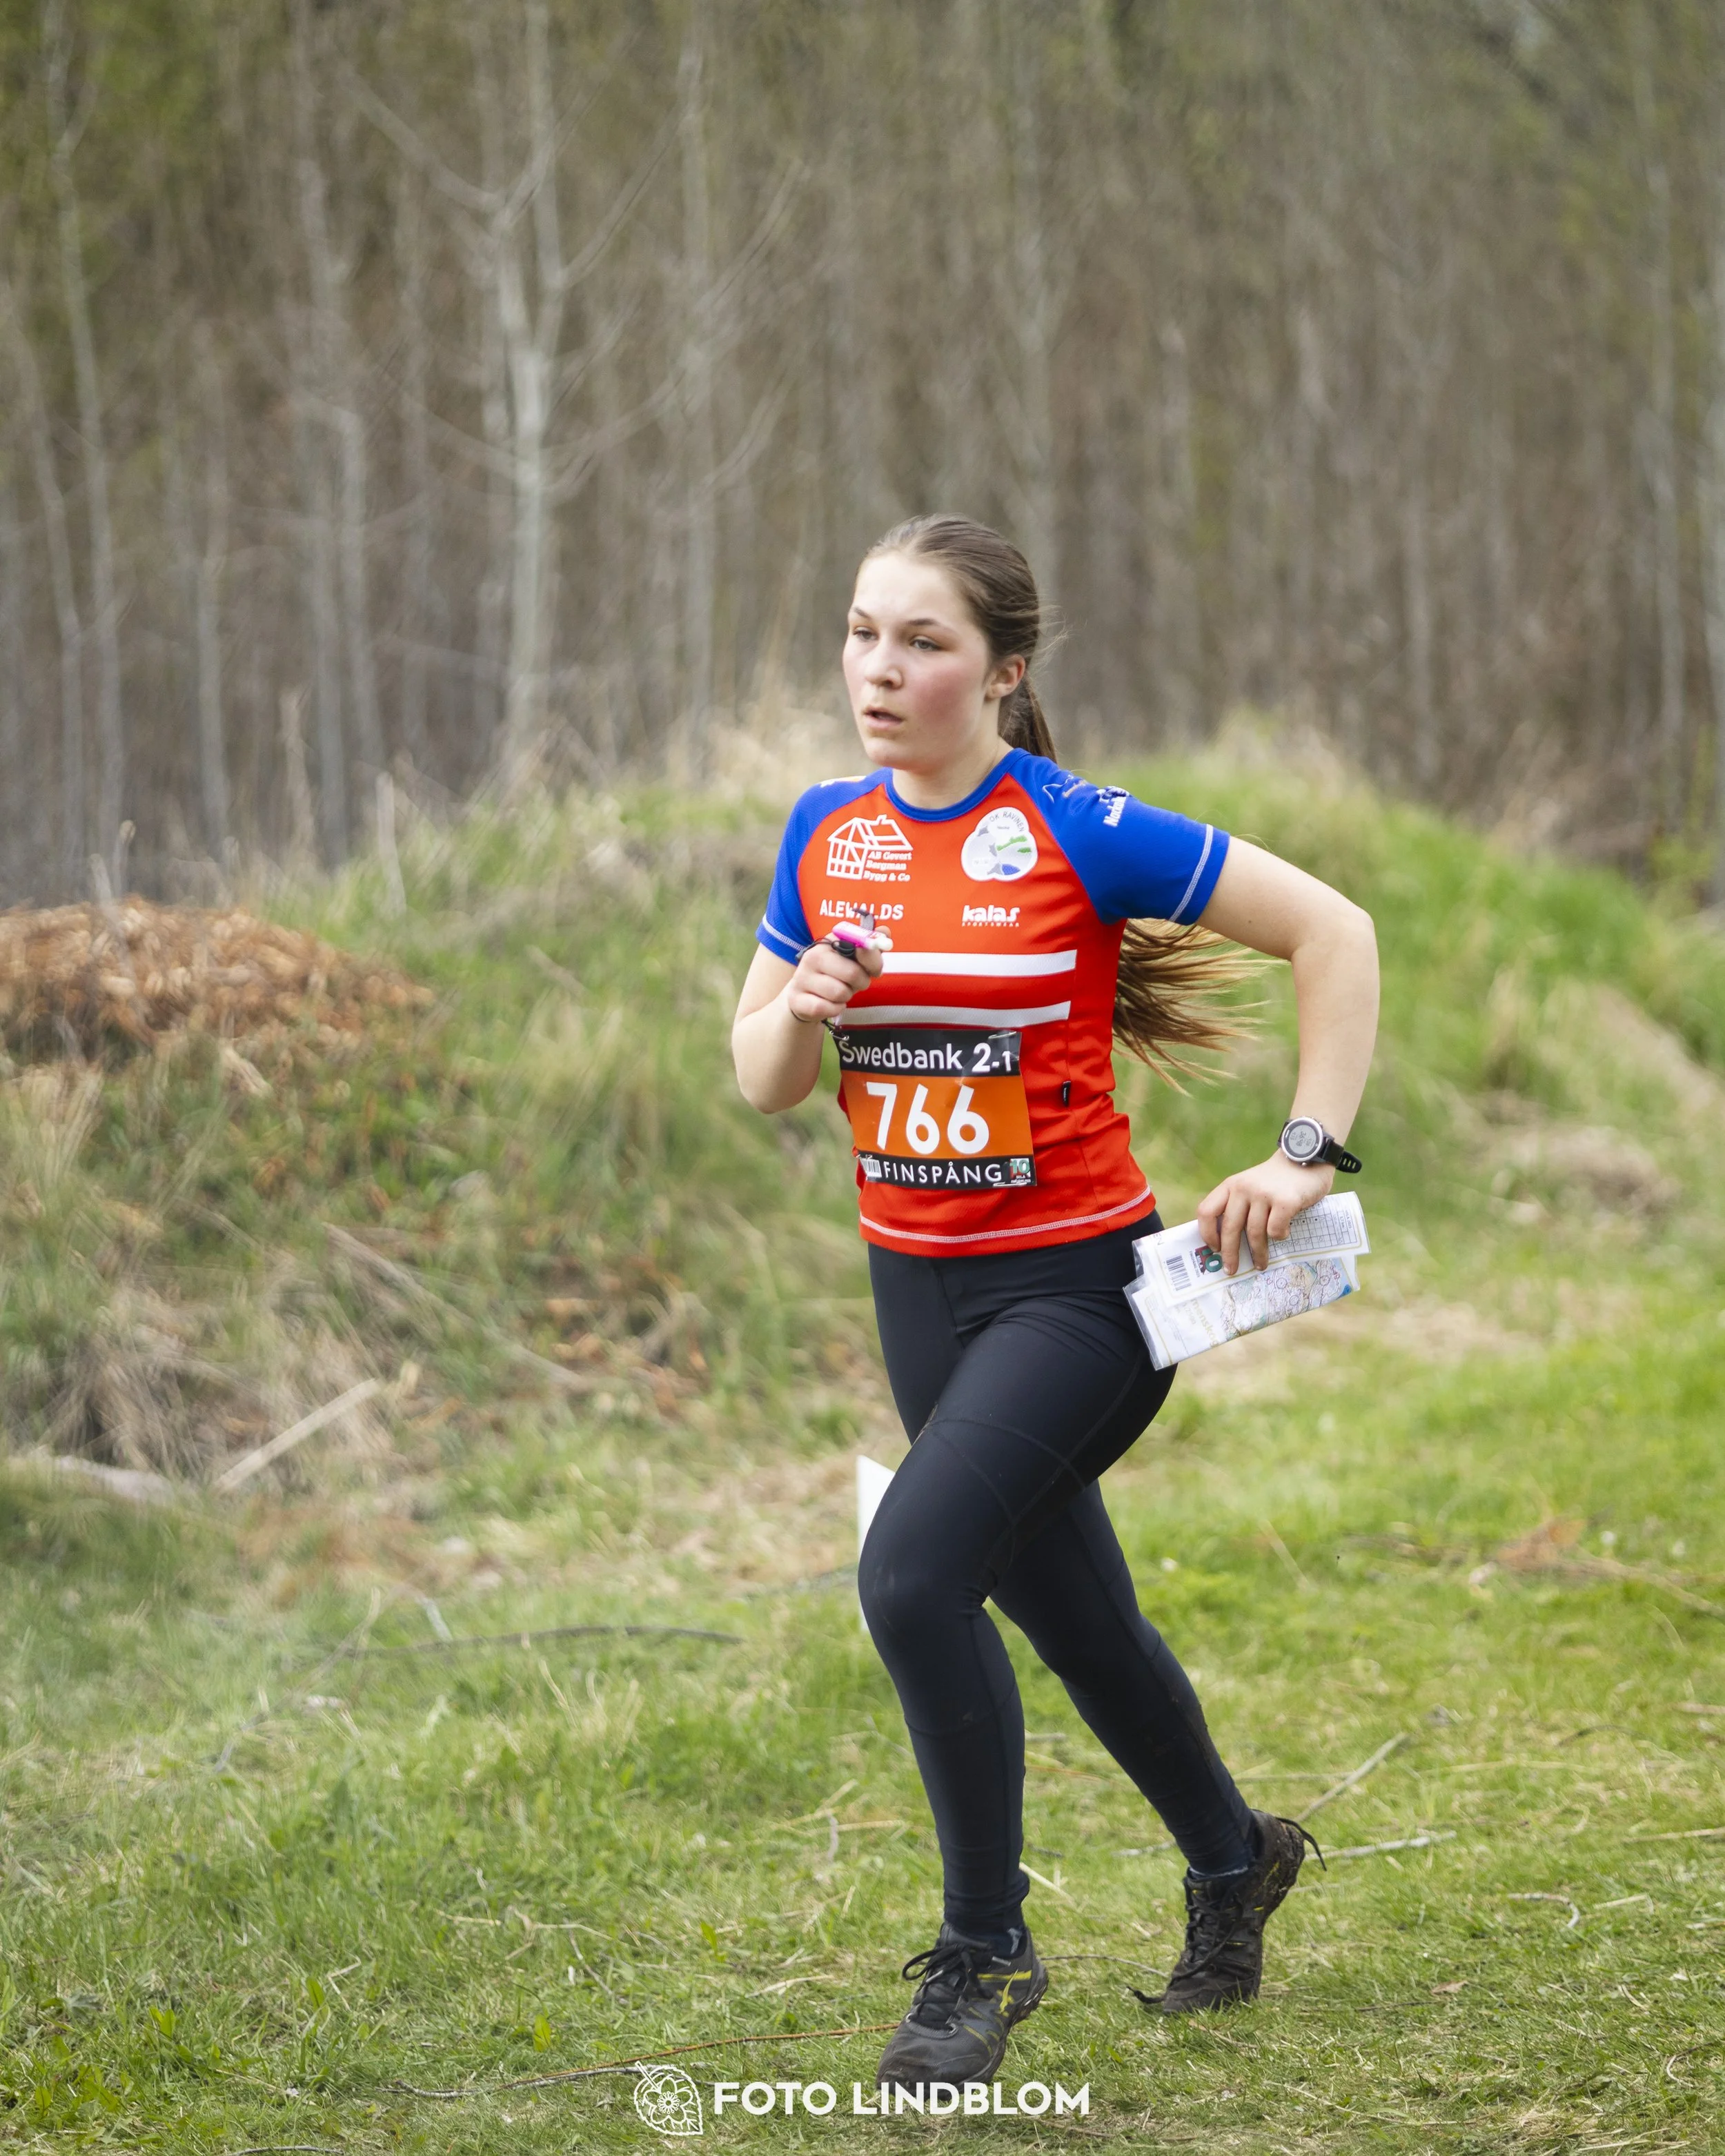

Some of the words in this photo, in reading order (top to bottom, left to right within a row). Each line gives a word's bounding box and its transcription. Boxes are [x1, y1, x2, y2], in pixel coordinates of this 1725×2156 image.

[989, 813, 1000, 822] OK
[1003, 811, 1025, 832] RAVINEN
[868, 851, 882, 860] AB
[866, 860, 907, 871] Bergman
[888, 872, 896, 881] &
[898, 873, 911, 882] Co
[962, 904, 1021, 922] kalas
[839, 1040, 963, 1069] Swedbank
[866, 1080, 989, 1155] 766
[883, 1160, 1002, 1184] FINSPÅNG
